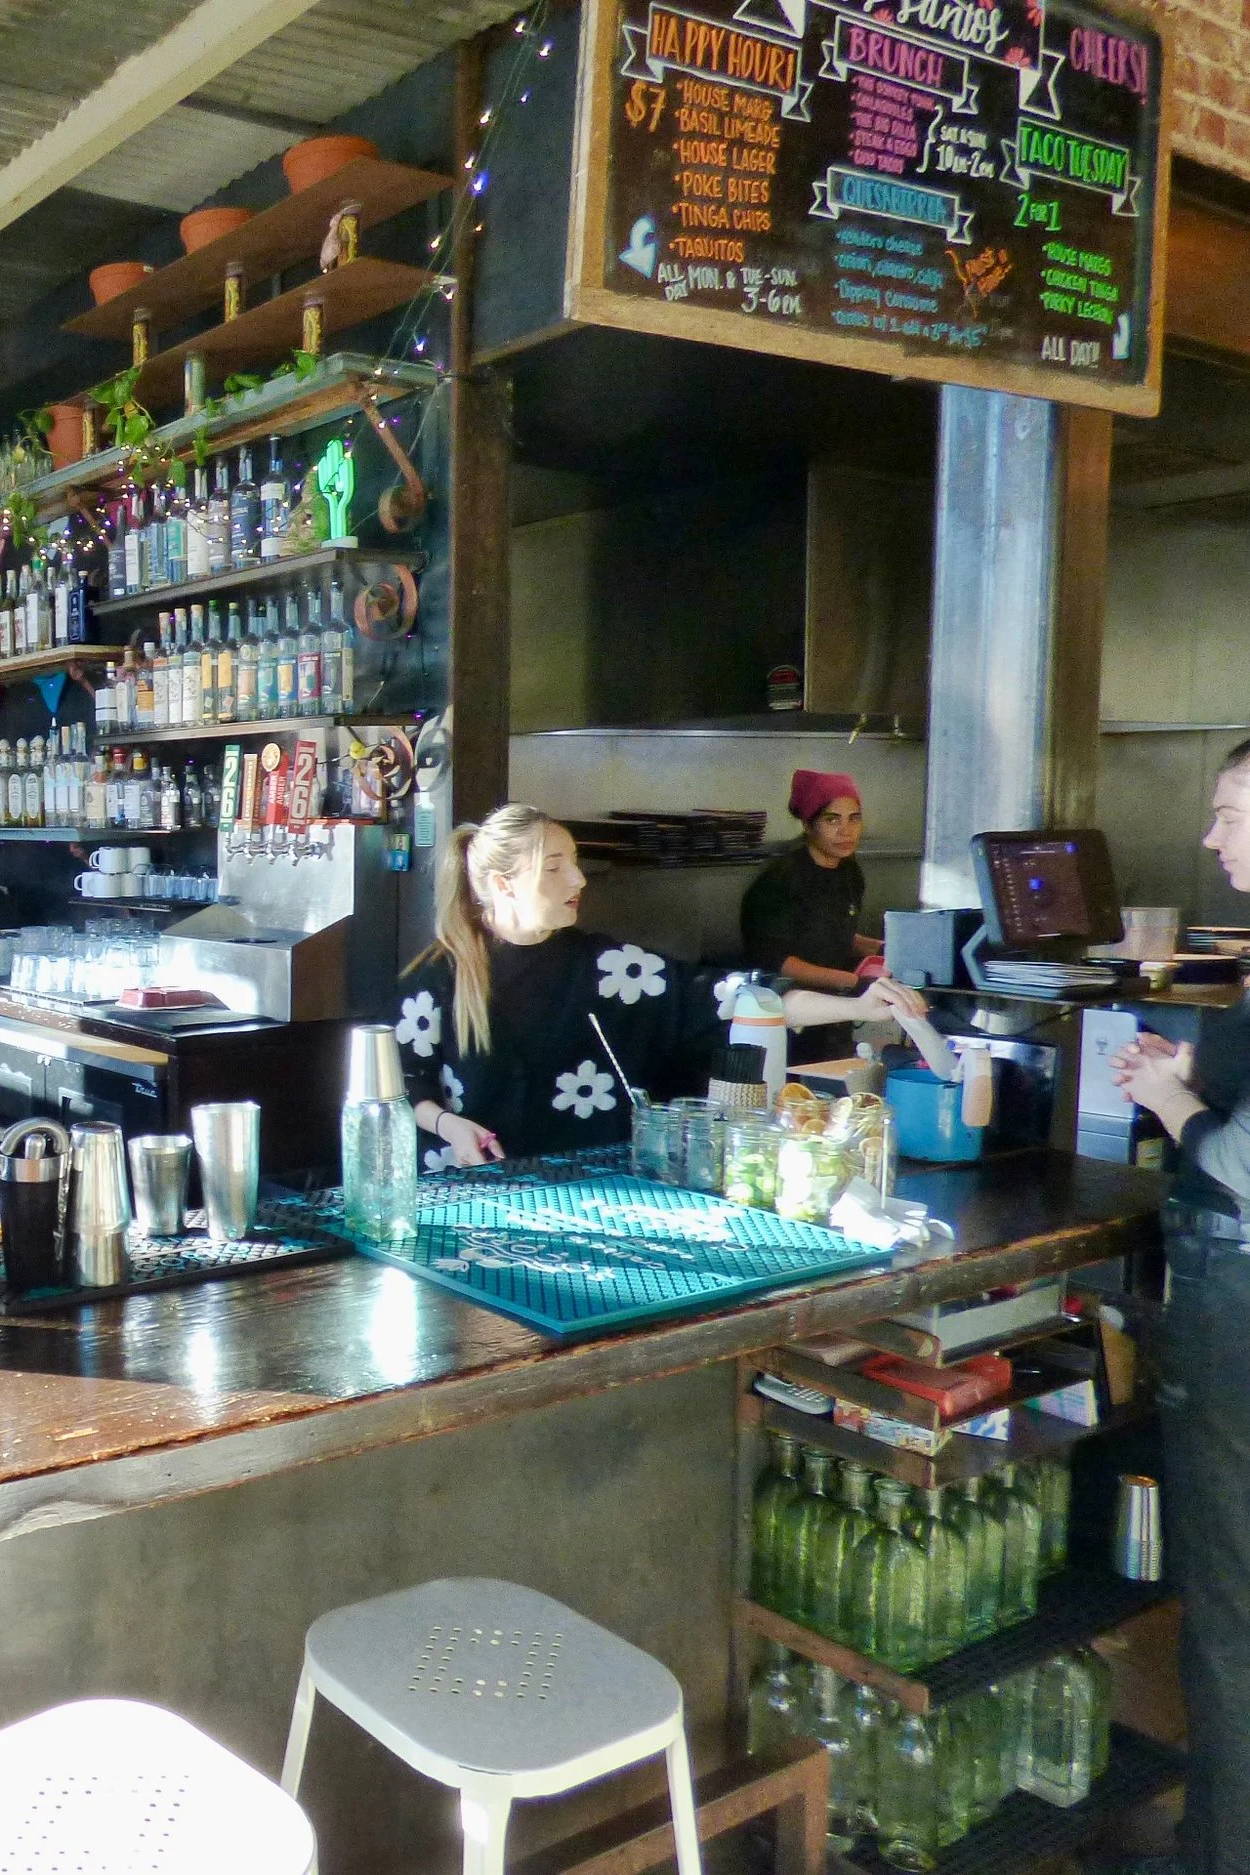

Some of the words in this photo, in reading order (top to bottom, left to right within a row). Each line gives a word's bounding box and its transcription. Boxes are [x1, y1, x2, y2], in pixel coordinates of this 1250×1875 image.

[652, 12, 725, 71] HAPPY
[849, 25, 944, 88] BRUNCH
[626, 80, 667, 133] $7
[681, 79, 730, 111] HOUSE
[679, 107, 721, 135] BASIL
[679, 139, 727, 167] HOUSE
[732, 148, 776, 175] LAGER
[1020, 126, 1066, 172] TACO
[1067, 139, 1127, 188] TUESDAY
[681, 170, 723, 198] POKE
[727, 177, 770, 203] BITES
[678, 202, 730, 229] TINGA
[732, 208, 772, 231] CHIPS
[1014, 193, 1030, 228] 2
[1045, 200, 1063, 231] 1
[675, 237, 745, 263] TAQUITOS
[1041, 335, 1067, 361] ALL
